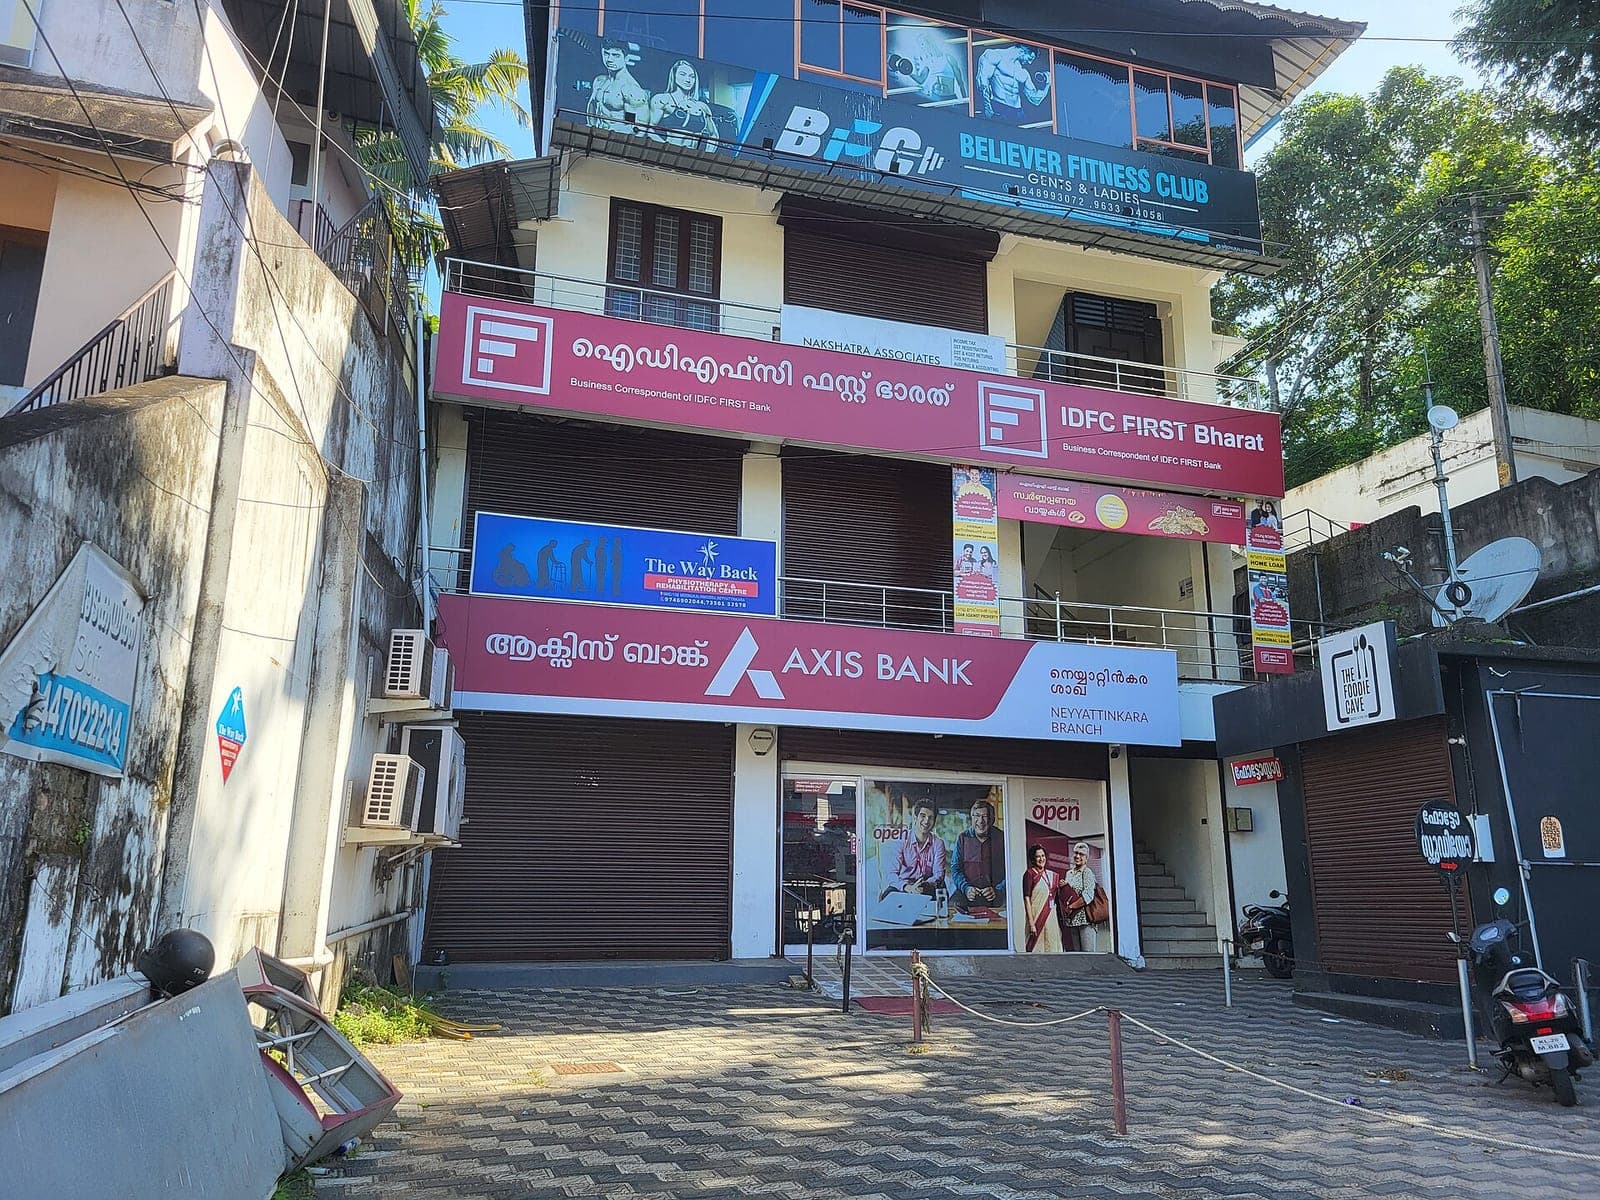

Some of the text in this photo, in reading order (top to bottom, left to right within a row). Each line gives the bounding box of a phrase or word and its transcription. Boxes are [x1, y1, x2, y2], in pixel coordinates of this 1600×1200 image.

[960, 133, 1209, 204] BELIEVER FITNESS CLUB
[1028, 173, 1140, 205] GENTS & LADIES
[803, 337, 941, 365] NAKSHATRA ASSOCIATES
[572, 338, 955, 407] ഐഡിഎഫ്സി ഫസ്റ്റ് ഭാരത്
[571, 378, 772, 412] Business Correspondent of IDFC FIRST Bank
[1061, 406, 1265, 452] IDFC FIRST Bharat
[1062, 442, 1222, 470] Business Correspondent of IDFC FIRST Bank
[644, 557, 758, 581] The Way Back
[655, 582, 747, 596] REHABILITATION CENTRE
[667, 578, 729, 589] PHYSIOTHERAPY
[485, 631, 710, 669] ആക്സിസ് ബാങ്ക്
[781, 647, 974, 687] AXIS BANK
[1050, 668, 1149, 688] നെയ്യാറ്റിൻകര
[1341, 667, 1355, 684] THE
[1050, 684, 1087, 696] ശാഖ
[1343, 680, 1371, 700] FOODIE
[1050, 706, 1149, 723] NEYYATTINKARA
[1345, 697, 1365, 715] CAVE
[28, 680, 123, 757] 447022214
[1051, 722, 1102, 736] BRANCH
[1032, 804, 1080, 825] open
[1422, 810, 1461, 830] ഫോട്ടോ
[873, 827, 909, 843] open
[1421, 829, 1472, 865] സ്റ്റുഡിയോ
